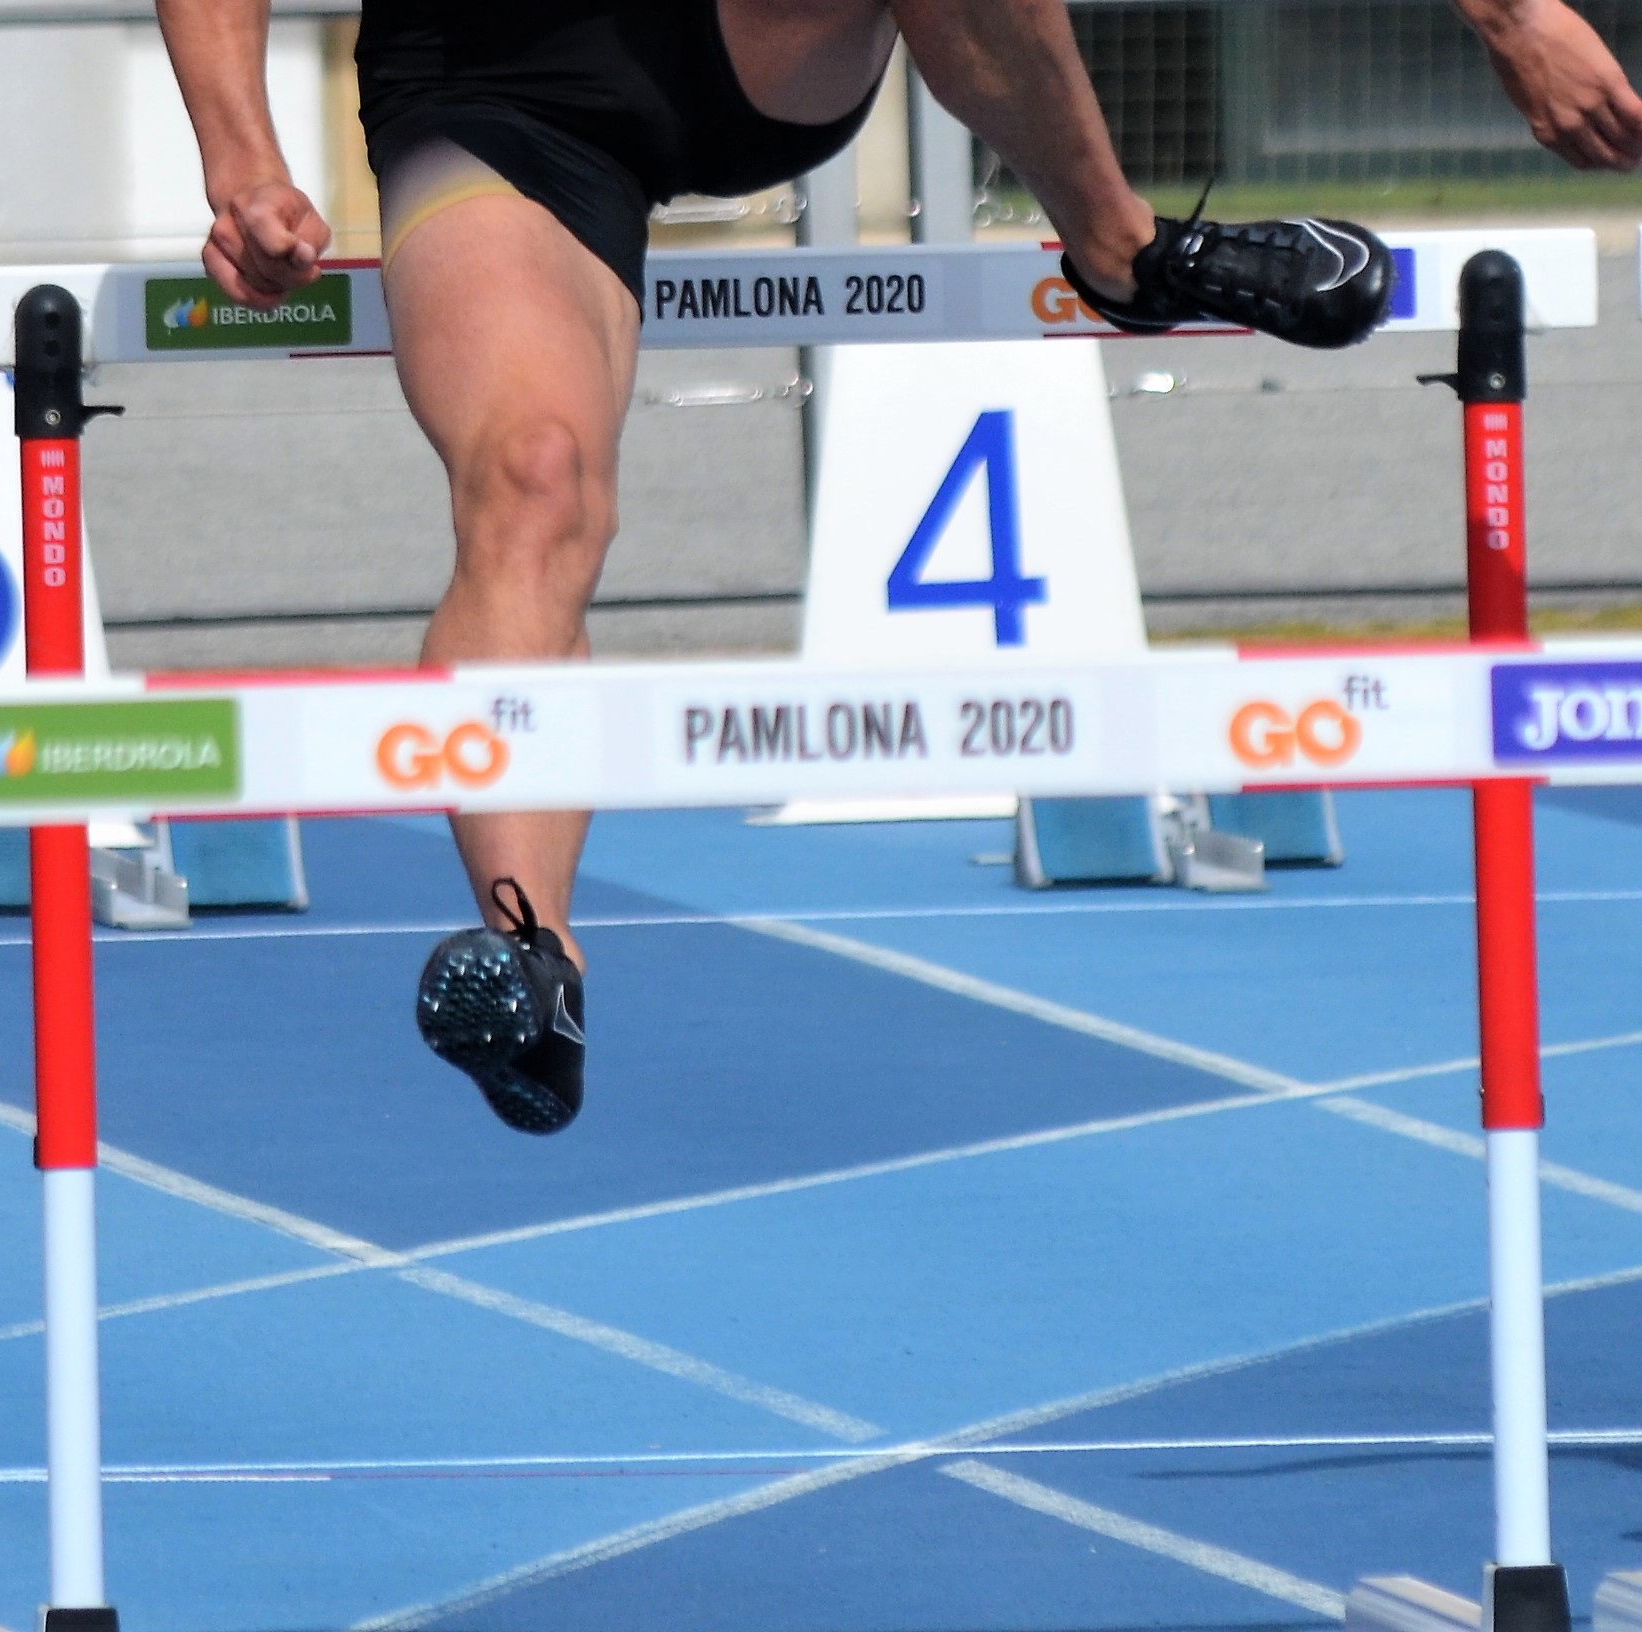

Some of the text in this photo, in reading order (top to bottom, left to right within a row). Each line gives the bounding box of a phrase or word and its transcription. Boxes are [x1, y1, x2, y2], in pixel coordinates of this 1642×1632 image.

[657, 274, 926, 319] PAMLONA 2020
[43, 475, 66, 588] MONDO
[886, 409, 1049, 647] 4
[1485, 438, 1509, 551] MONDO
[41, 732, 221, 772] IBERDROLA
[376, 696, 536, 791] GO fit
[684, 698, 1075, 765] PAMLONA 2020
[1228, 674, 1388, 769] GO fit
